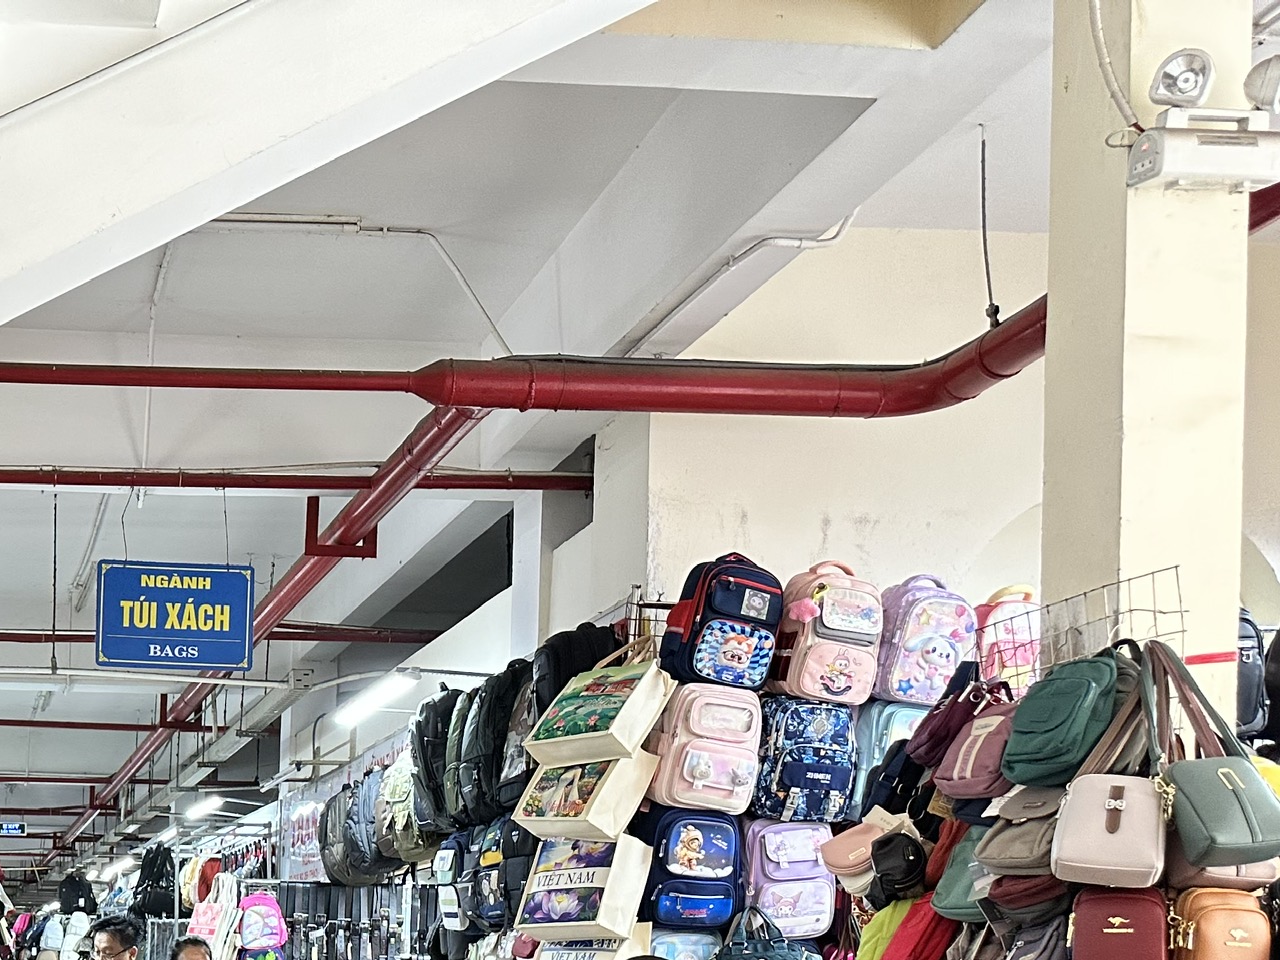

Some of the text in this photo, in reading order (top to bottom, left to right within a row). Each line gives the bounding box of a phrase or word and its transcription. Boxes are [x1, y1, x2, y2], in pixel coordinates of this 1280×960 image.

[140, 573, 211, 590] NGÀNH
[120, 595, 231, 632] TÚI XÁCH
[148, 644, 199, 659] BAGS
[564, 870, 597, 886] NAM
